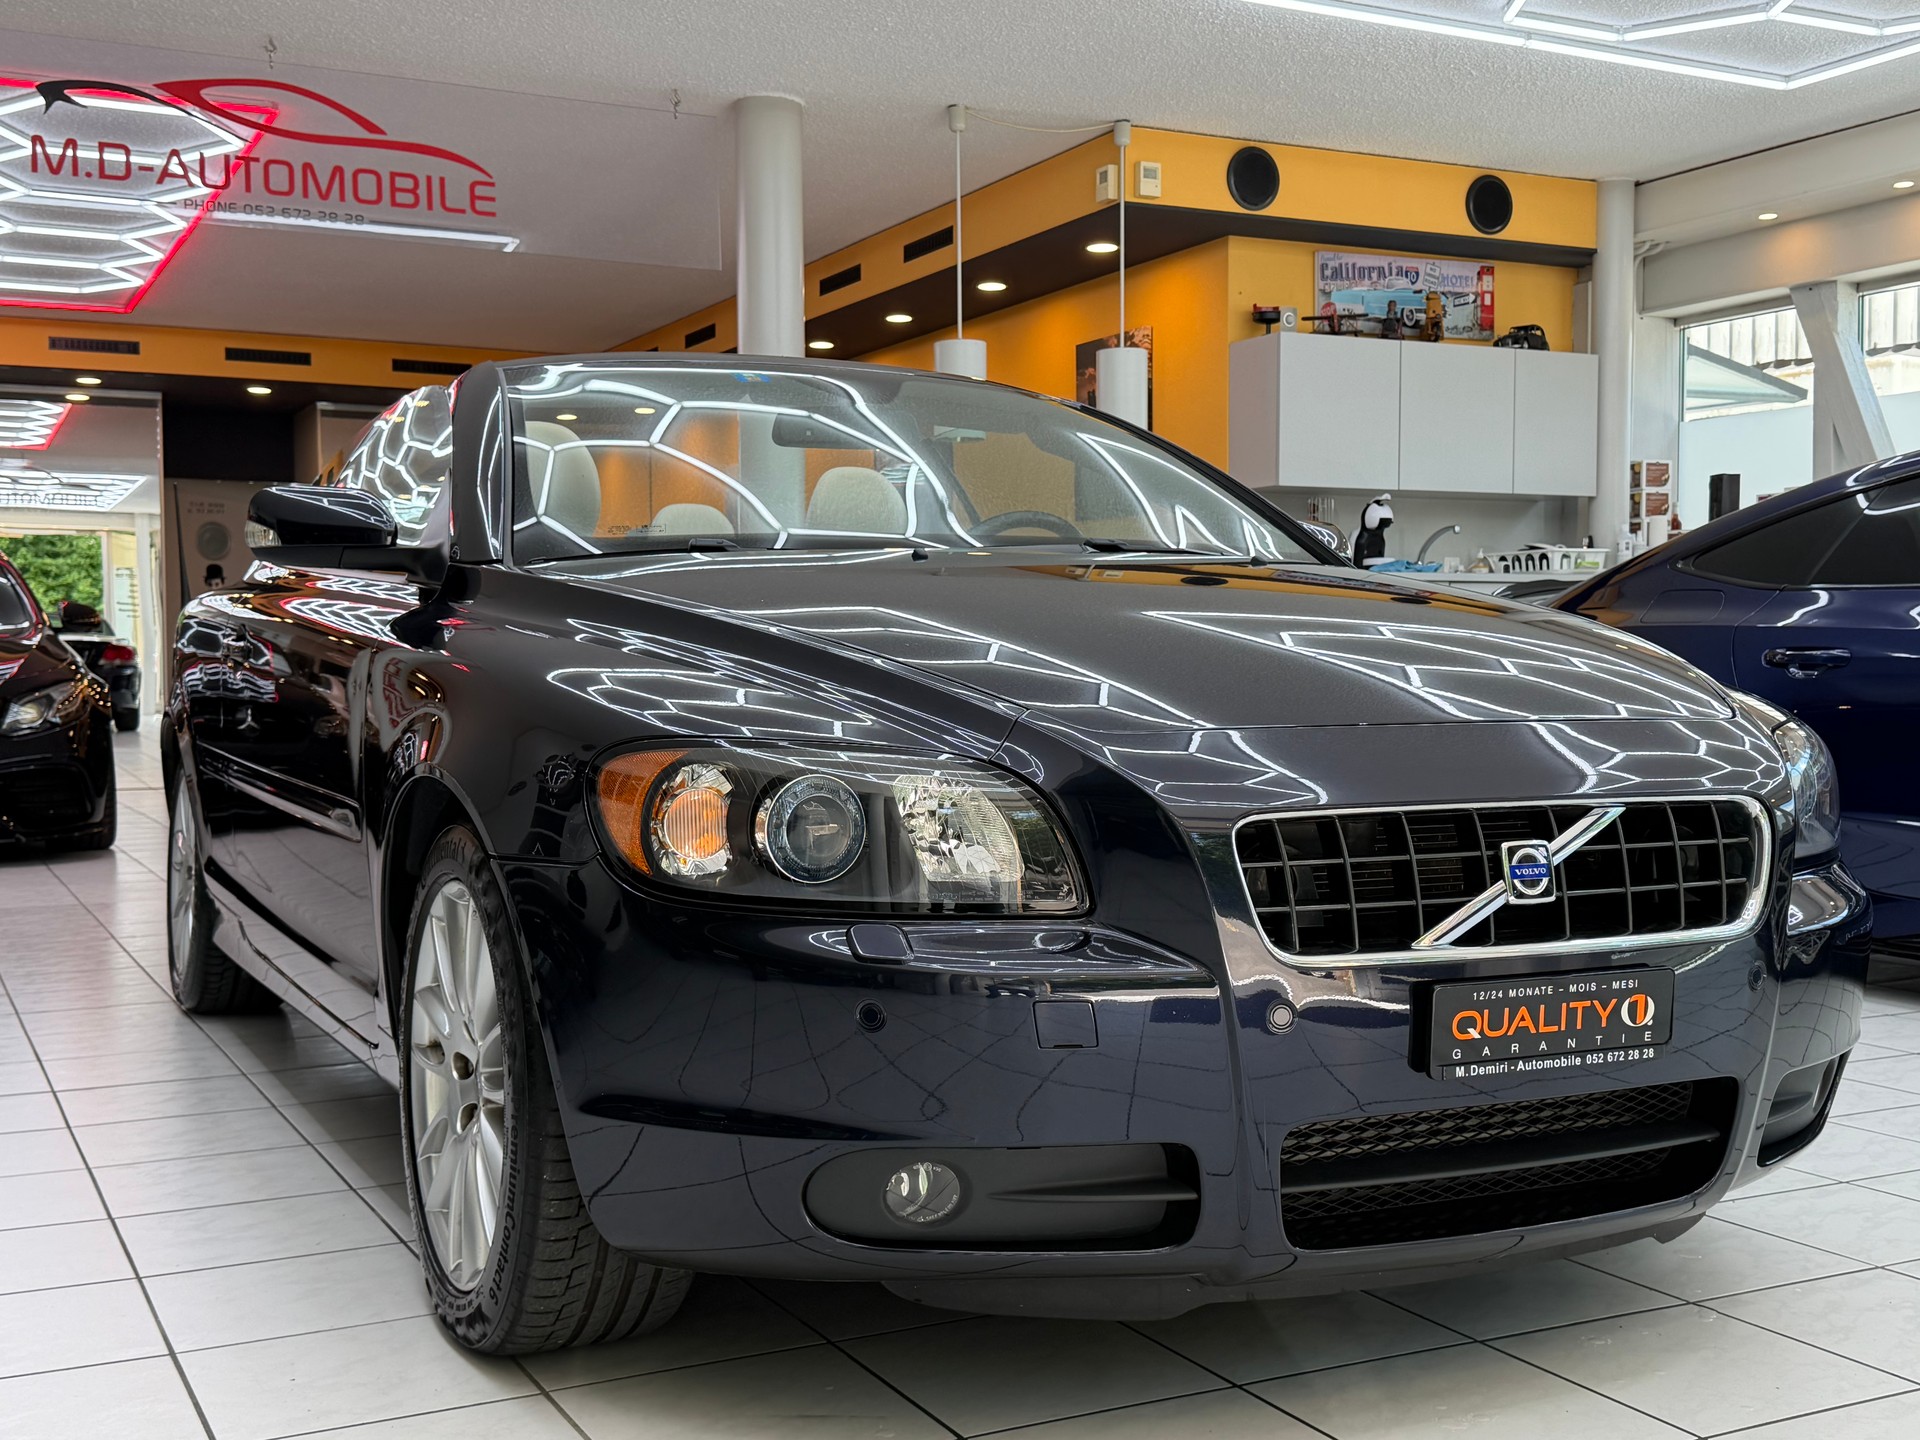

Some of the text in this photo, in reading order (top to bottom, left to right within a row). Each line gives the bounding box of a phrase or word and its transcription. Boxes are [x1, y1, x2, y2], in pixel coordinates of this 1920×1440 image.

[183, 198, 238, 213] PHONE
[1320, 262, 1404, 281] California
[1407, 271, 1417, 281] 10
[1514, 867, 1547, 876] VOLVO
[1473, 990, 1503, 1001] 12/24
[1509, 986, 1554, 998] MONATE
[1569, 982, 1597, 993] MOIS
[1612, 979, 1639, 990] MESI
[1452, 998, 1618, 1041] QUALITY
[1452, 1031, 1652, 1060] GARANTIE
[1517, 1055, 1582, 1072] Automobile
[1586, 1052, 1604, 1065] 052
[1607, 1050, 1625, 1063] 672
[1628, 1049, 1640, 1061] 28
[1643, 1048, 1655, 1059] 28
